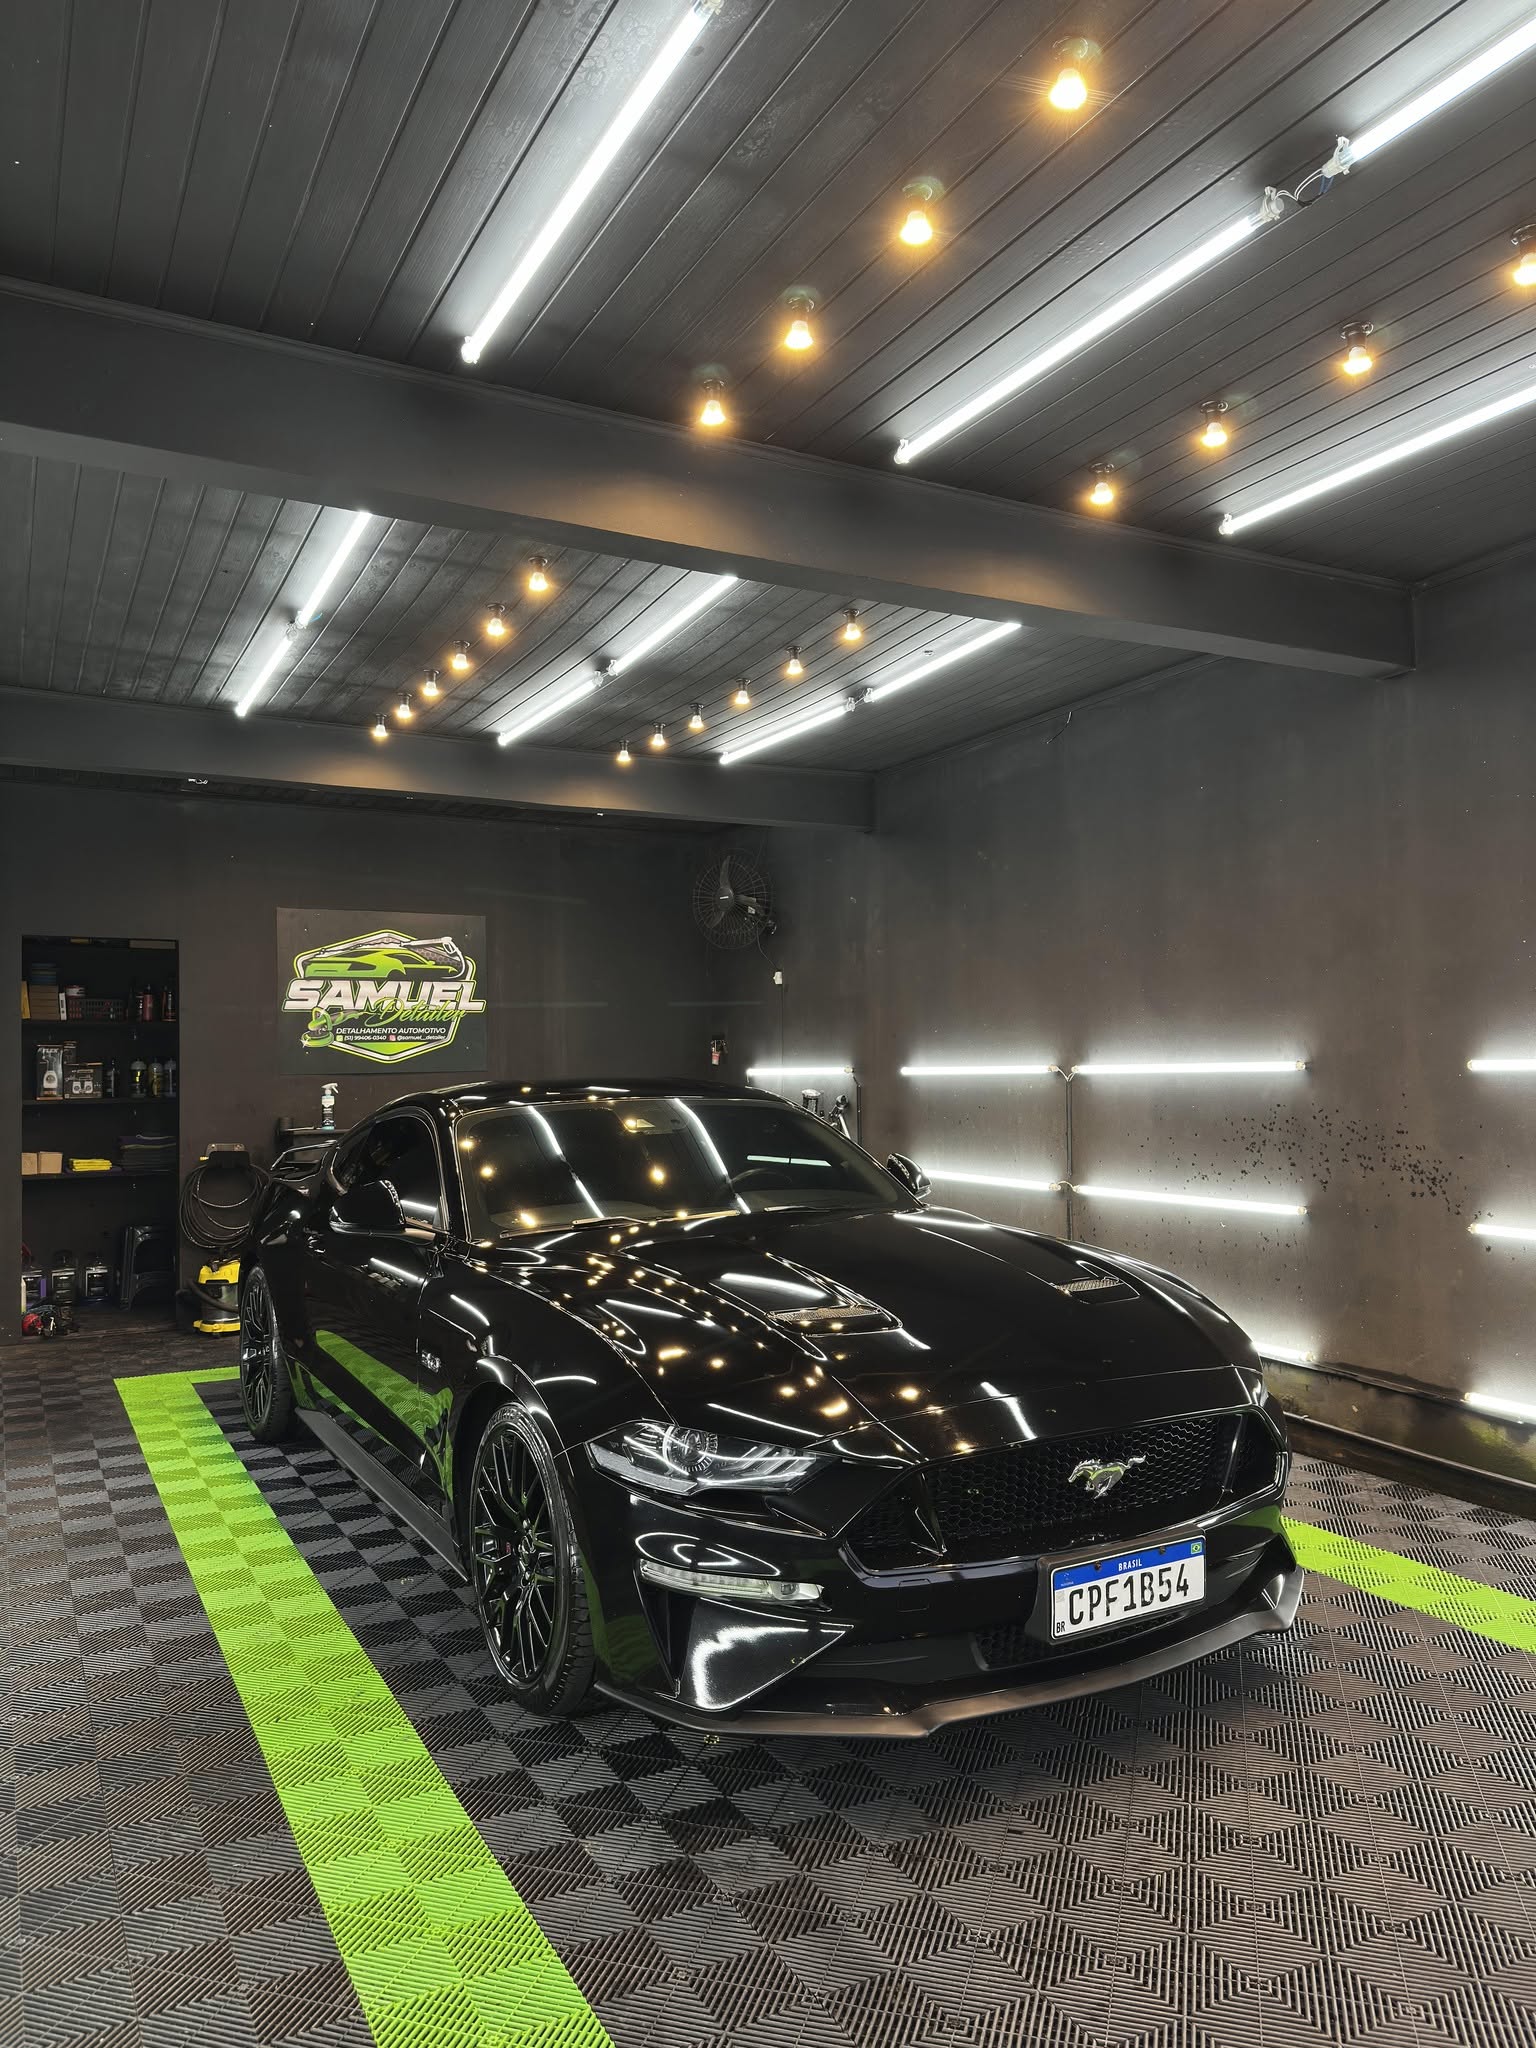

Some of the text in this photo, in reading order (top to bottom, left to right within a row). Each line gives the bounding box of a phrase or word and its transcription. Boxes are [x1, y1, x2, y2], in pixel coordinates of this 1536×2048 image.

[283, 979, 486, 1012] SAMUEL
[1118, 1558, 1143, 1572] BRASIL
[1069, 1563, 1189, 1626] CPF1B54
[1056, 1621, 1065, 1634] BR
